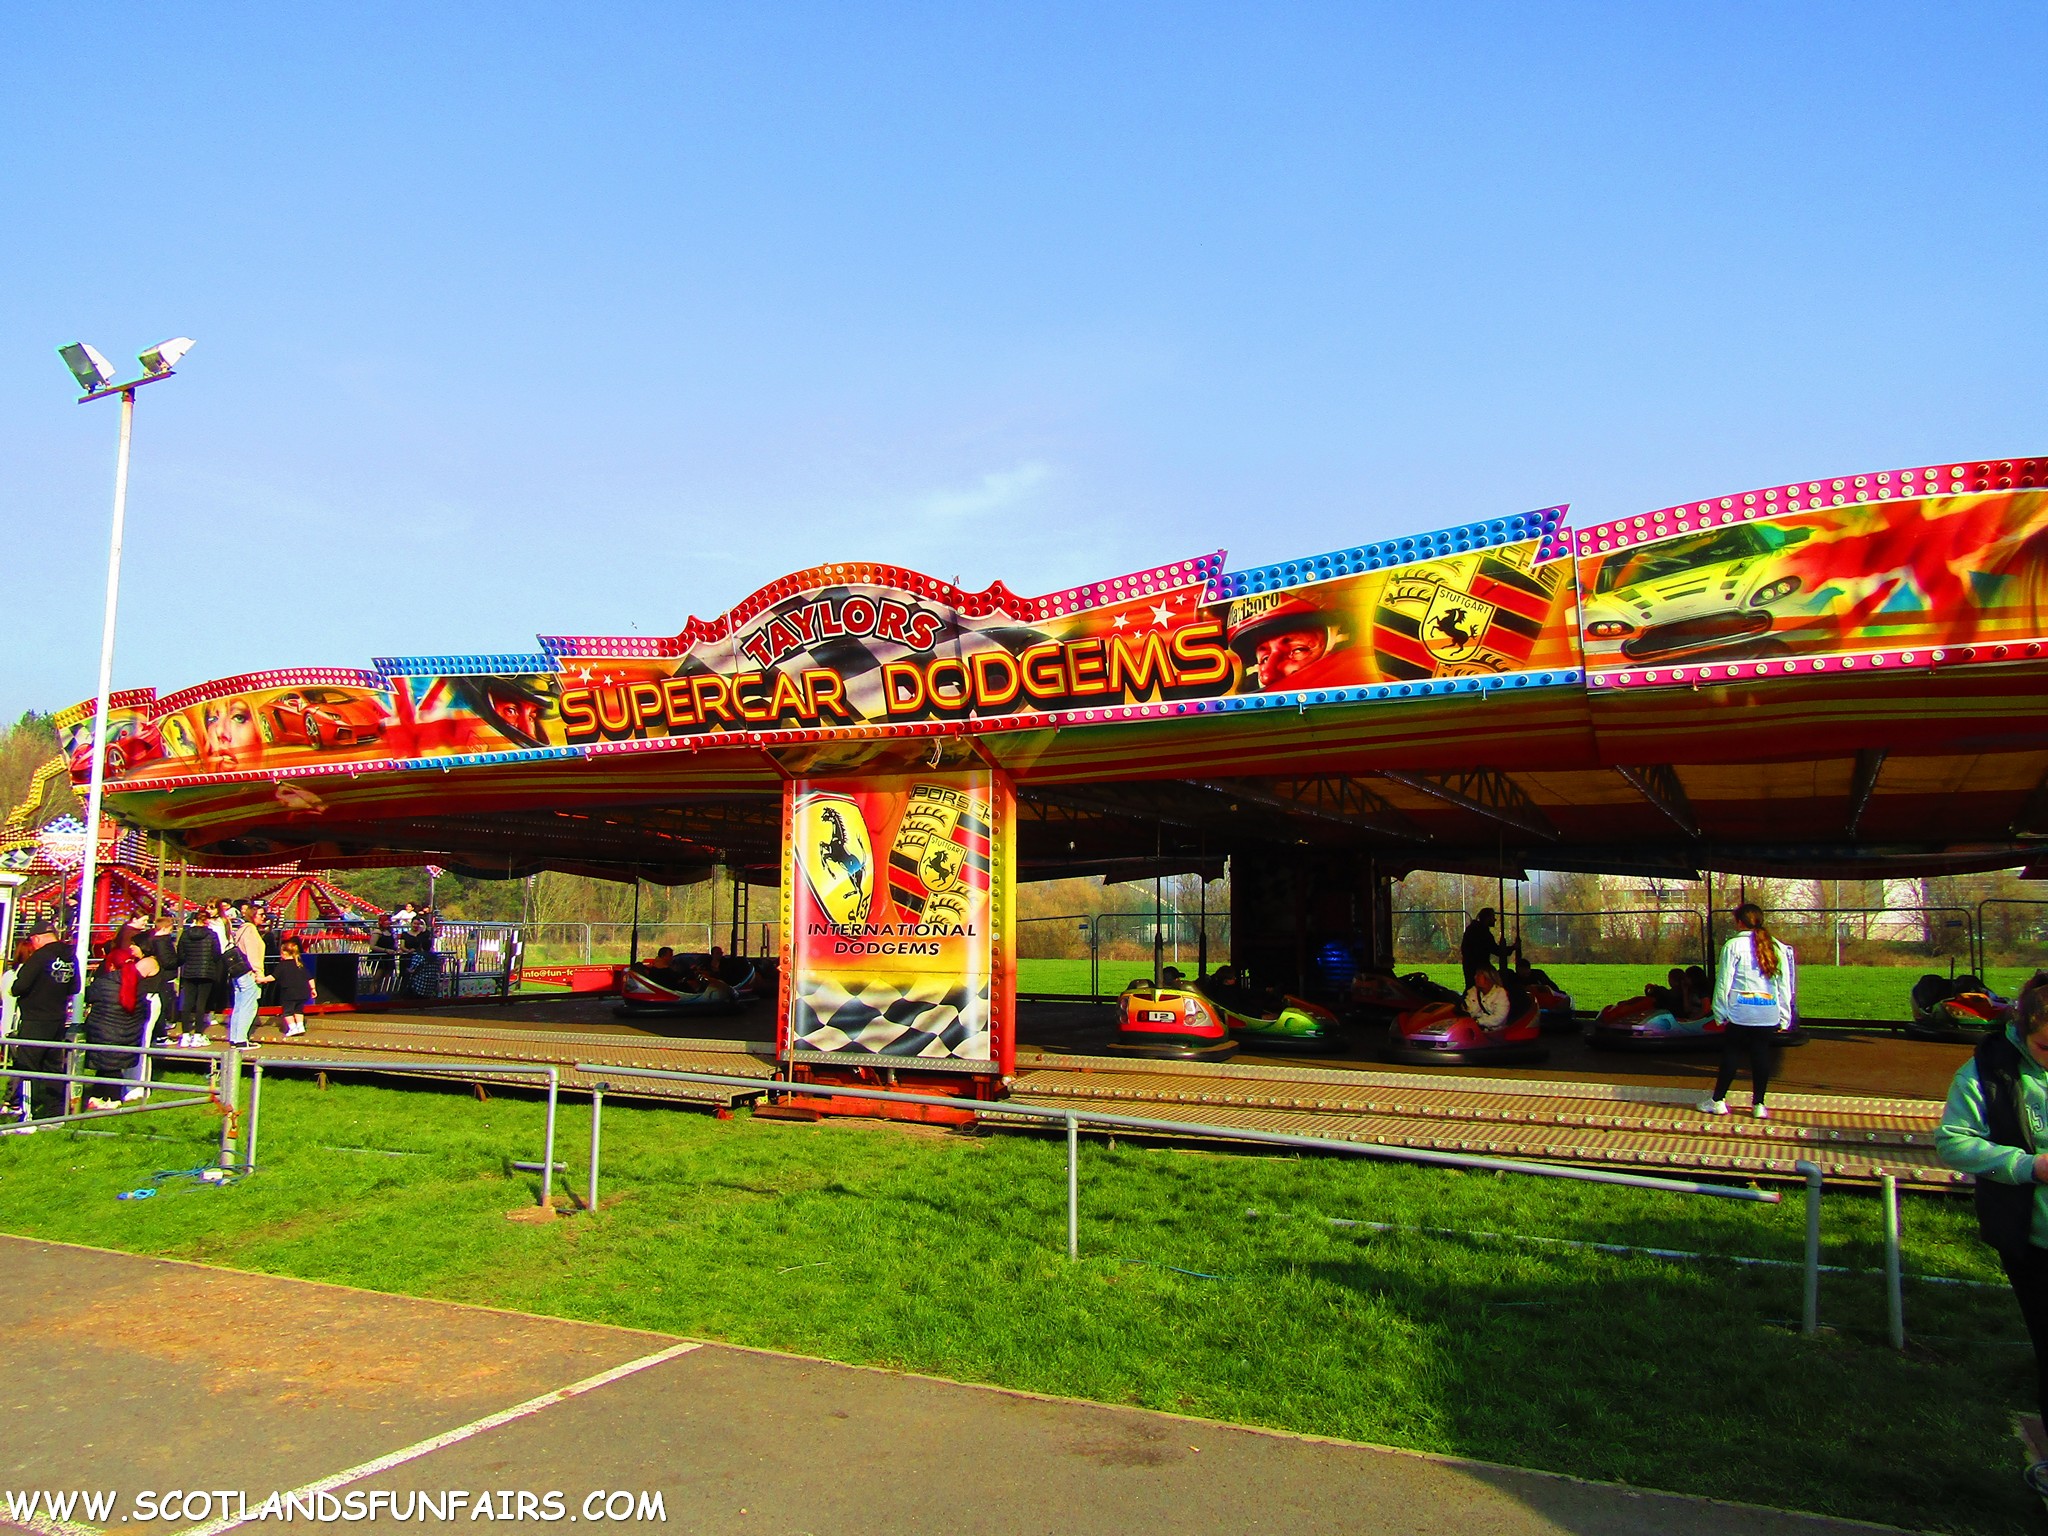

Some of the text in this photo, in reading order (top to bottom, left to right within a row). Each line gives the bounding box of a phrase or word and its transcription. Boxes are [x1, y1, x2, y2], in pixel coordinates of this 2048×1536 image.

[1439, 589, 1490, 614] STUTTGART
[743, 597, 943, 669] TAYLORS
[561, 620, 1229, 736] SUPERCAR DODGEMS
[930, 836, 965, 856] STUTTGART
[808, 923, 977, 938] INTERNATIONAL
[834, 942, 940, 956] DODGEMS
